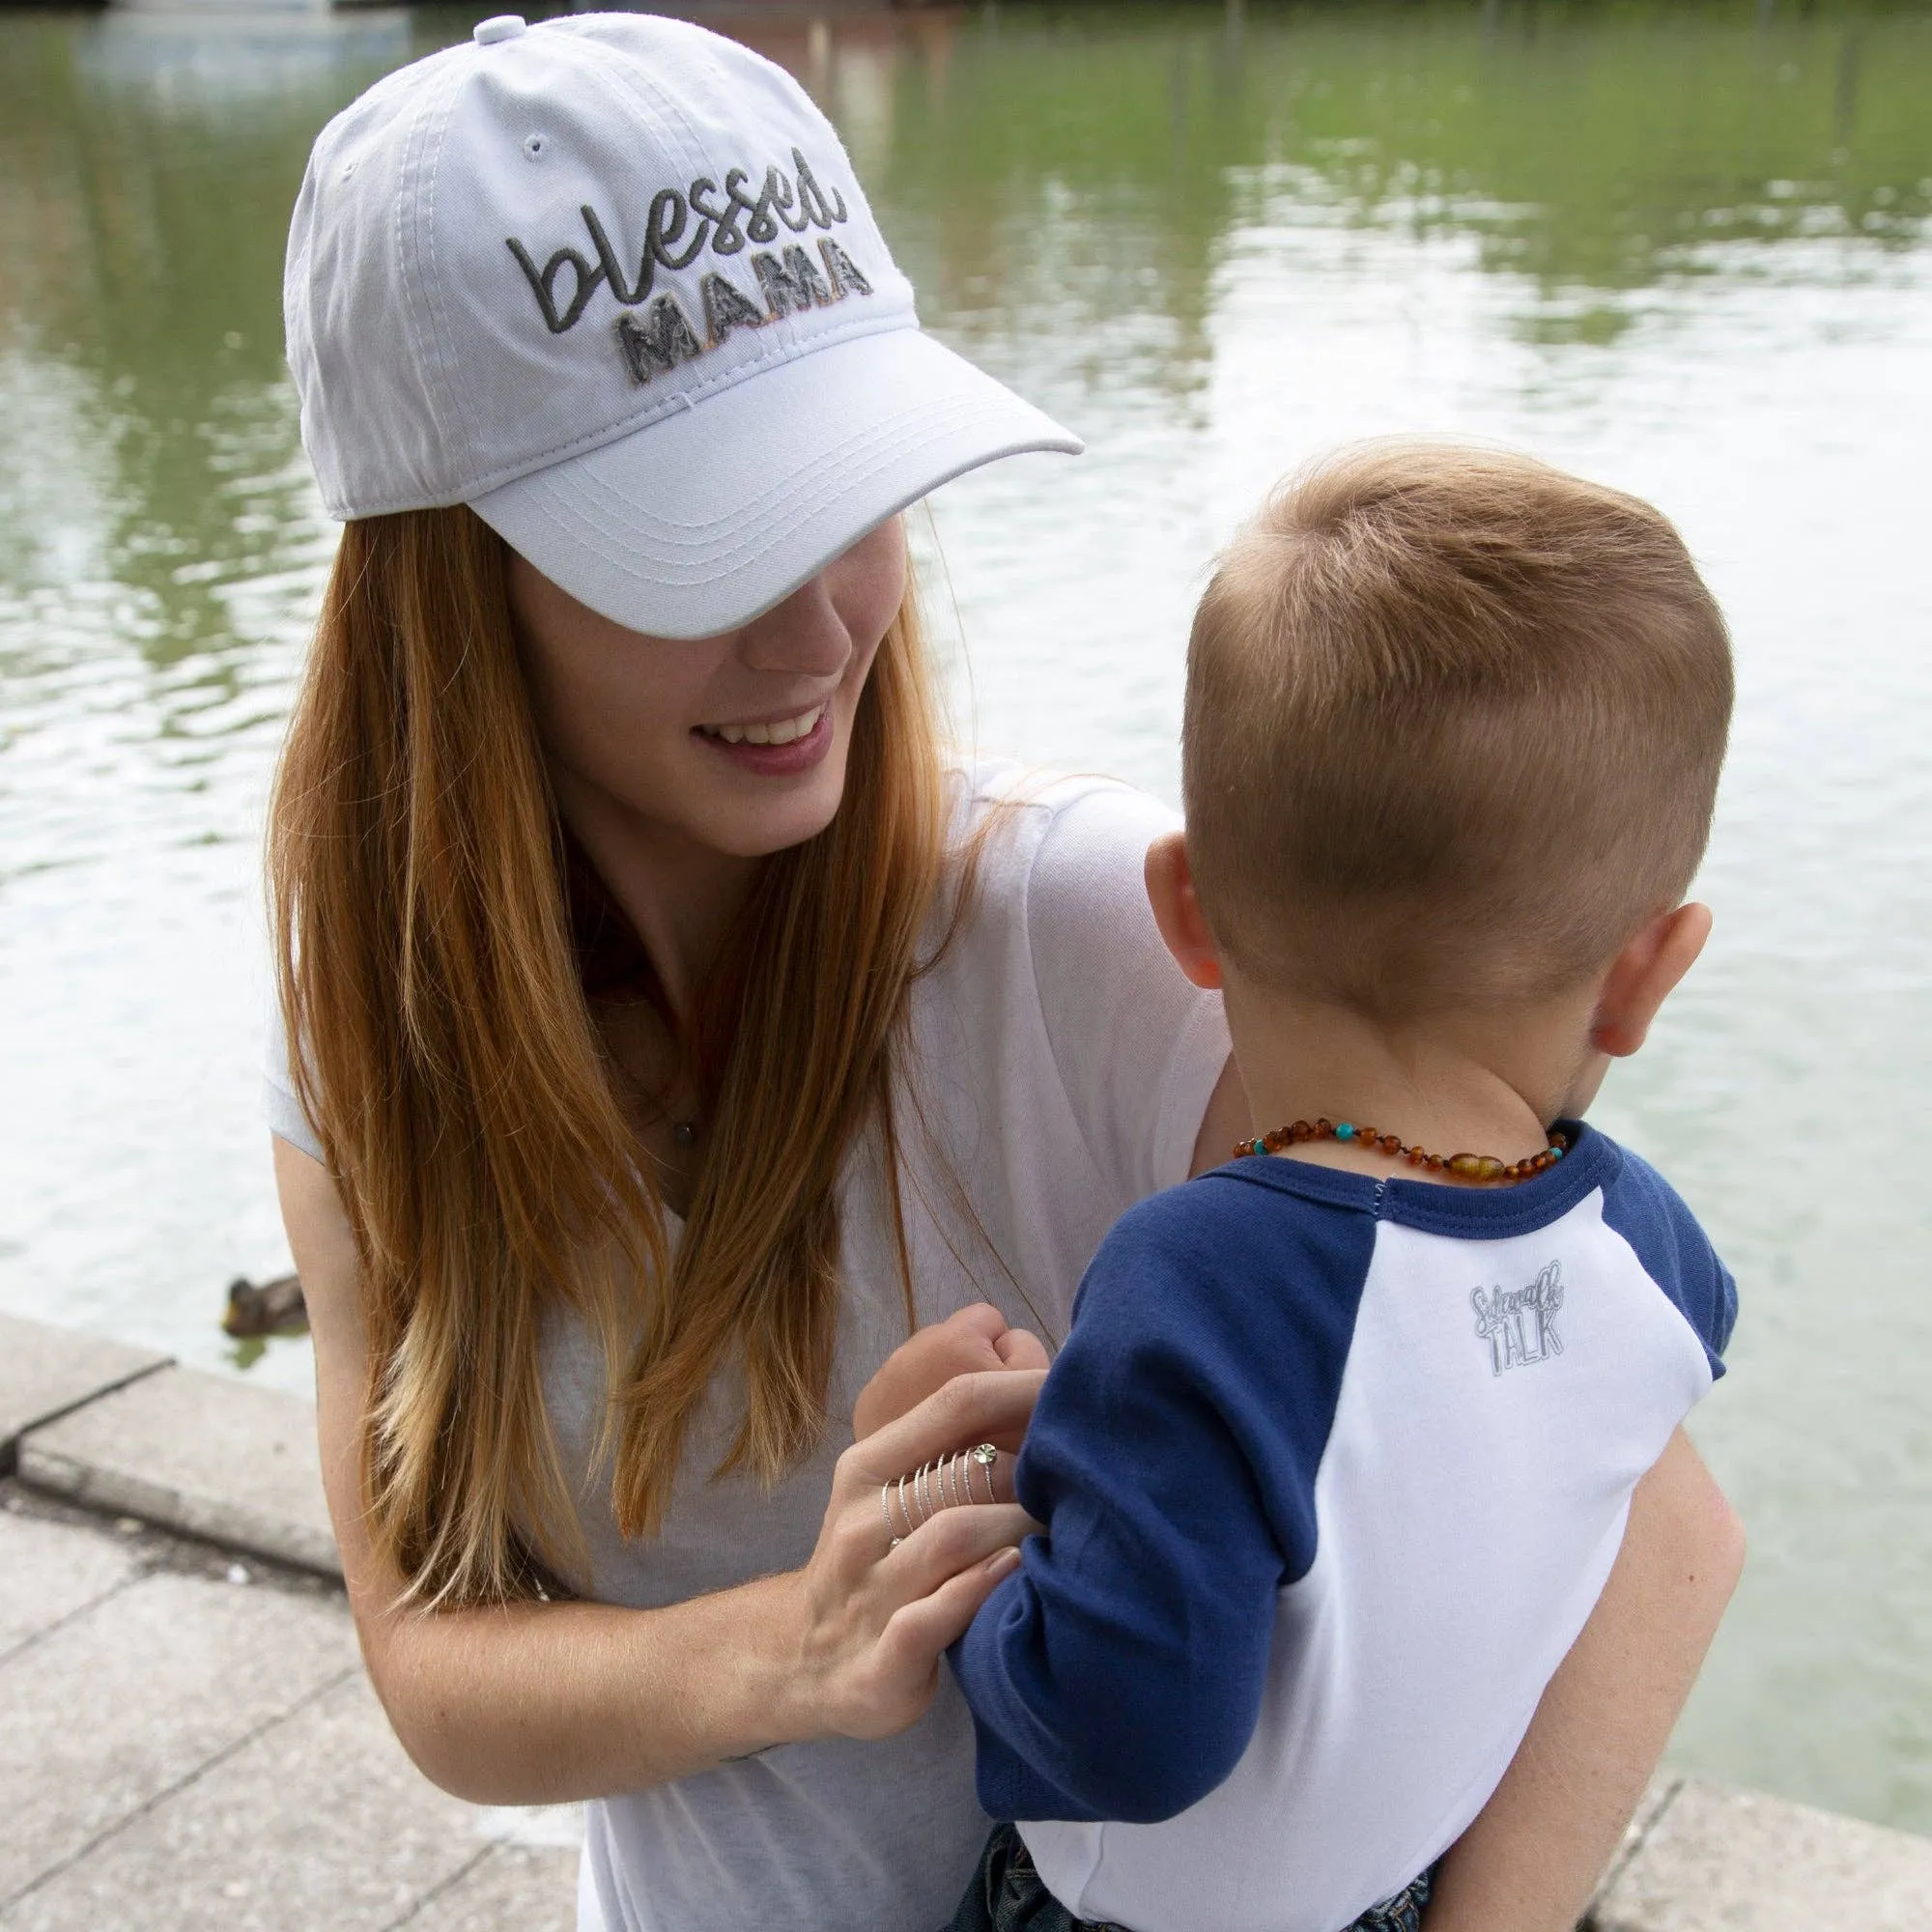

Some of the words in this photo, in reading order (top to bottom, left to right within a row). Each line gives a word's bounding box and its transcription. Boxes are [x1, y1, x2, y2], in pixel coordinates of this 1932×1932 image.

[505, 147, 848, 334] blessed
[611, 236, 875, 386] MAMA
[1484, 1308, 1564, 1377] TALK
